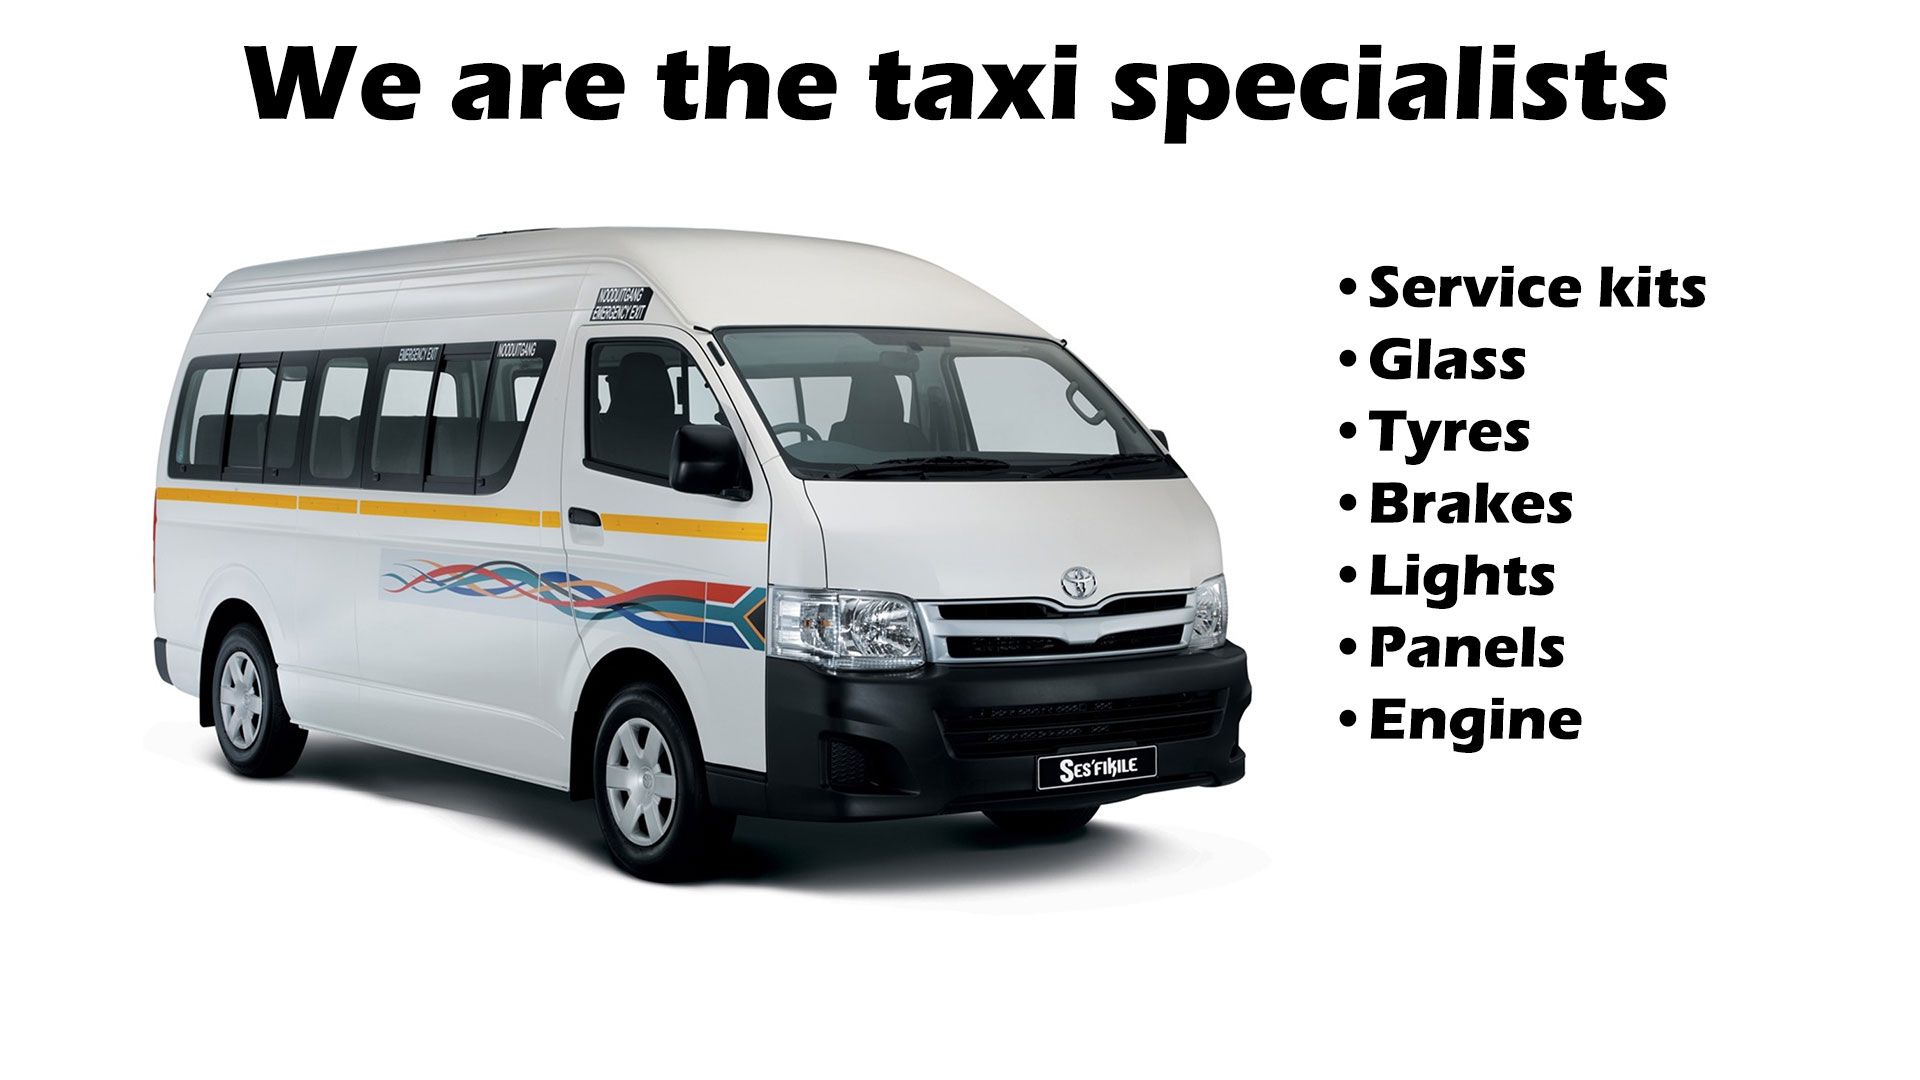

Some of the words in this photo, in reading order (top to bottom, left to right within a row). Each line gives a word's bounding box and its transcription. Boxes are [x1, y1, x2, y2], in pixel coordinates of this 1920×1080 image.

[592, 305, 630, 320] EMERGENCY
[629, 305, 646, 319] EXIT
[398, 348, 428, 361] EMERGENCY
[427, 347, 439, 360] EXIT
